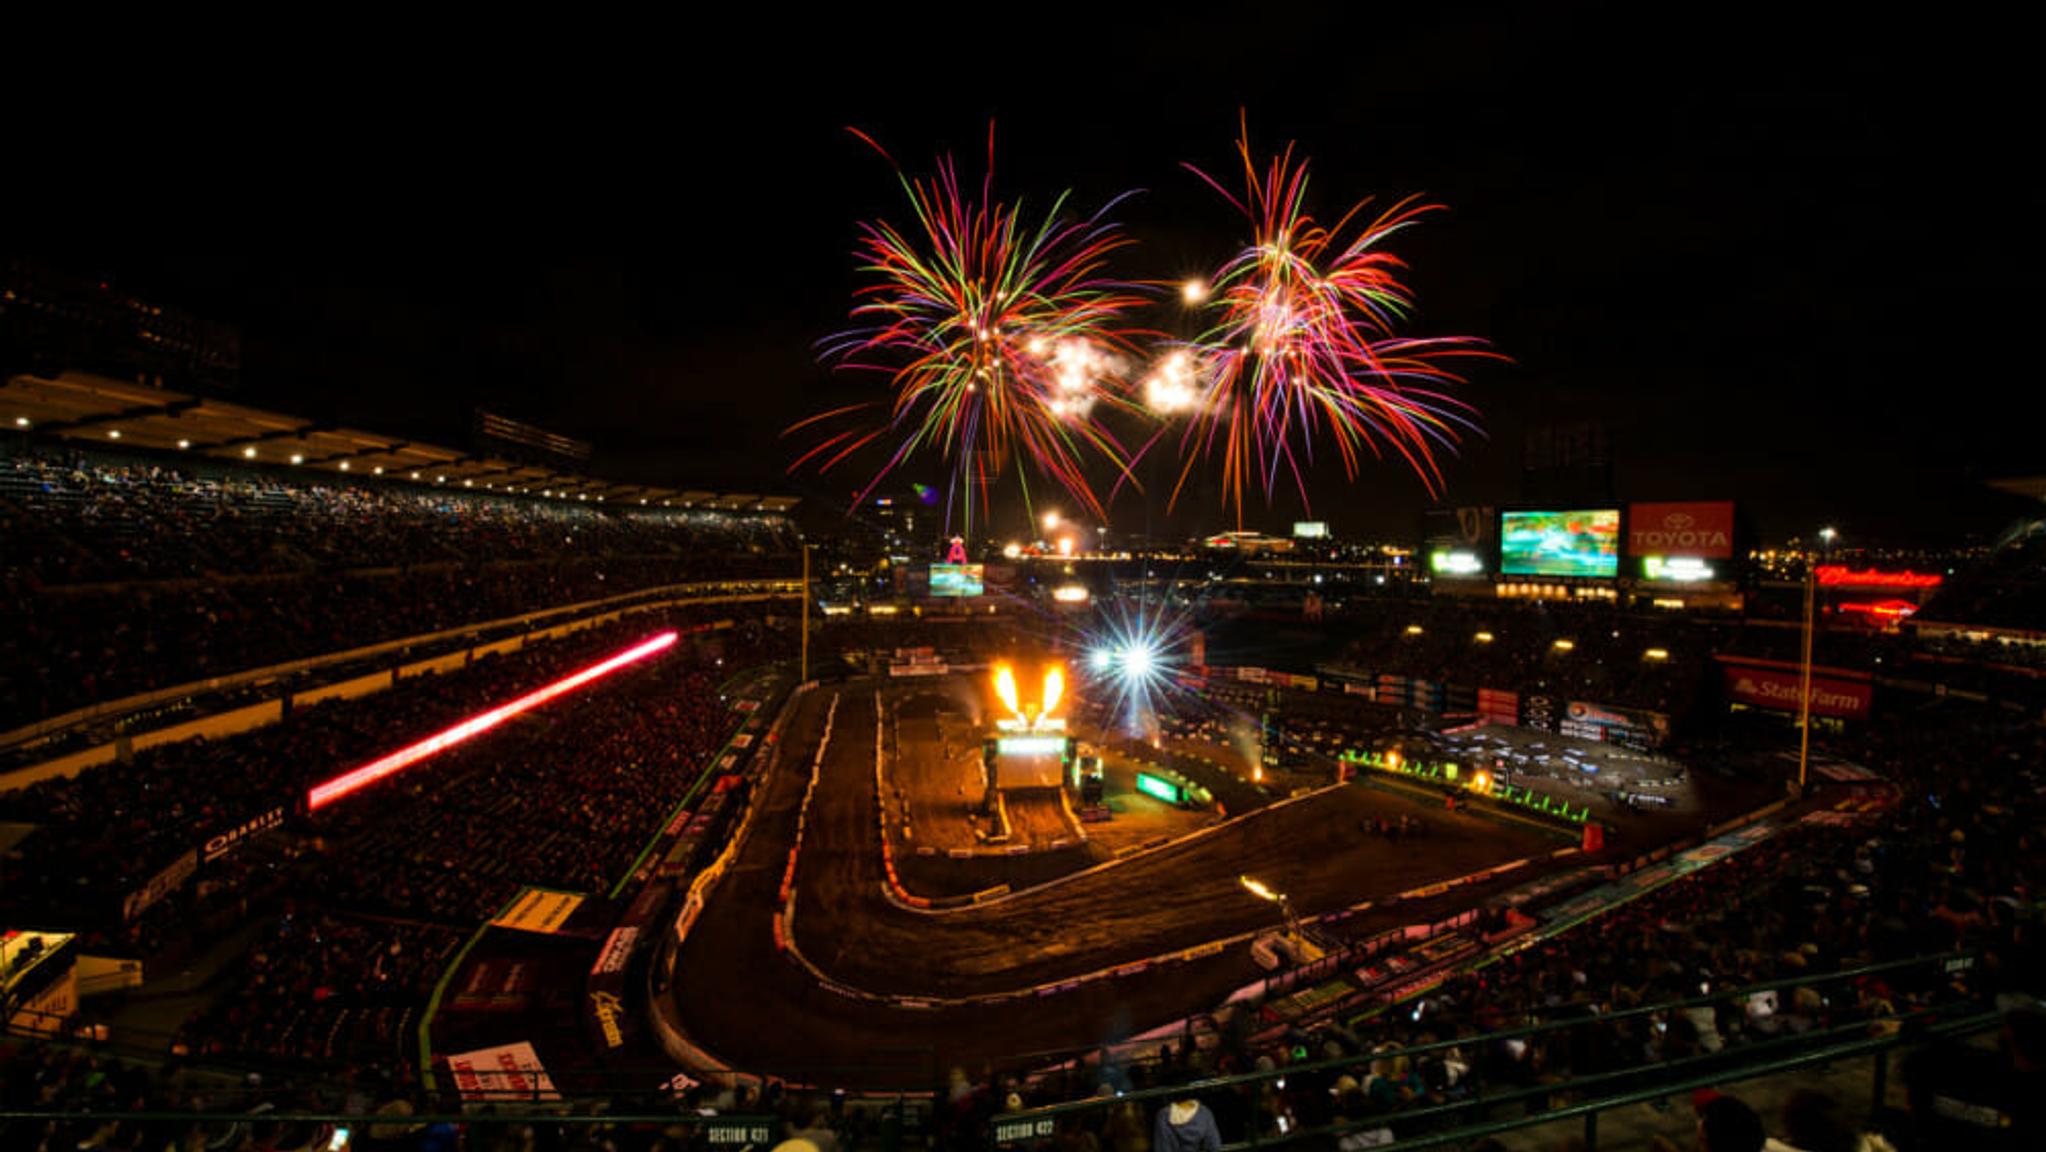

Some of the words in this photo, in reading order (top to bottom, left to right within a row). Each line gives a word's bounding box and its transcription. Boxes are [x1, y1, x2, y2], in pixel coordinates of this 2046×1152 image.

[1632, 531, 1728, 547] TOYOTA
[708, 1126, 747, 1143] SECTION
[996, 1123, 1033, 1142] SECTION
